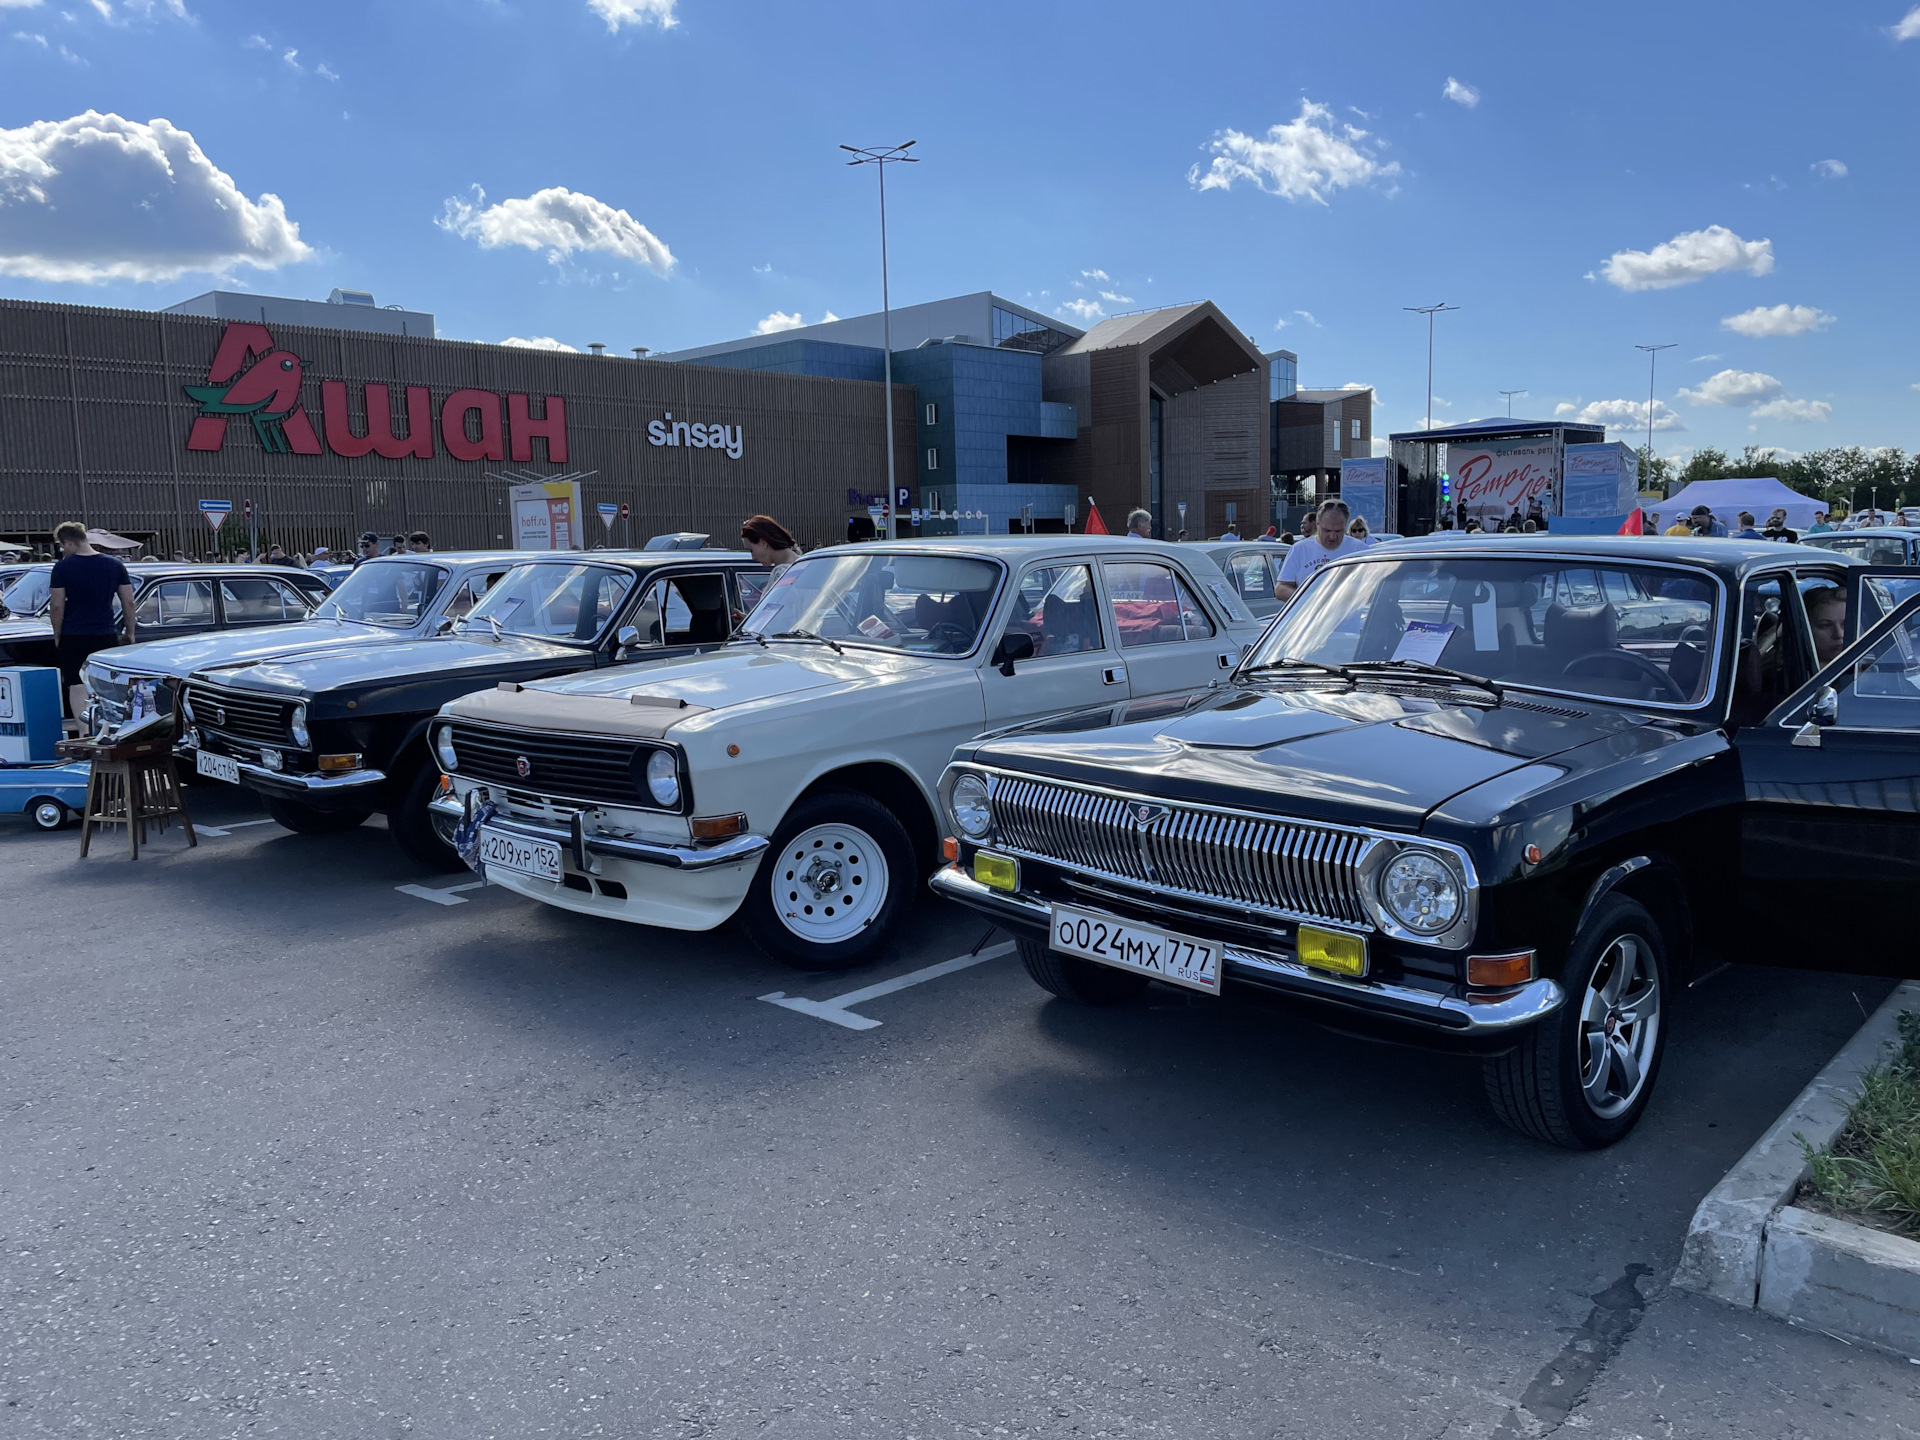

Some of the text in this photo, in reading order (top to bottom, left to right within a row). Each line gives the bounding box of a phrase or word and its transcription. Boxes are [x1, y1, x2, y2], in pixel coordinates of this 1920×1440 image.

[648, 412, 744, 460] sinsay
[1496, 448, 1535, 458] фестиваль
[521, 516, 547, 527] hoff.ru
[0, 723, 26, 736] НЗИН
[484, 837, 555, 867] Х209ХР 152
[1059, 918, 1211, 972] О024МХ 777
[1178, 967, 1199, 981] RUS
